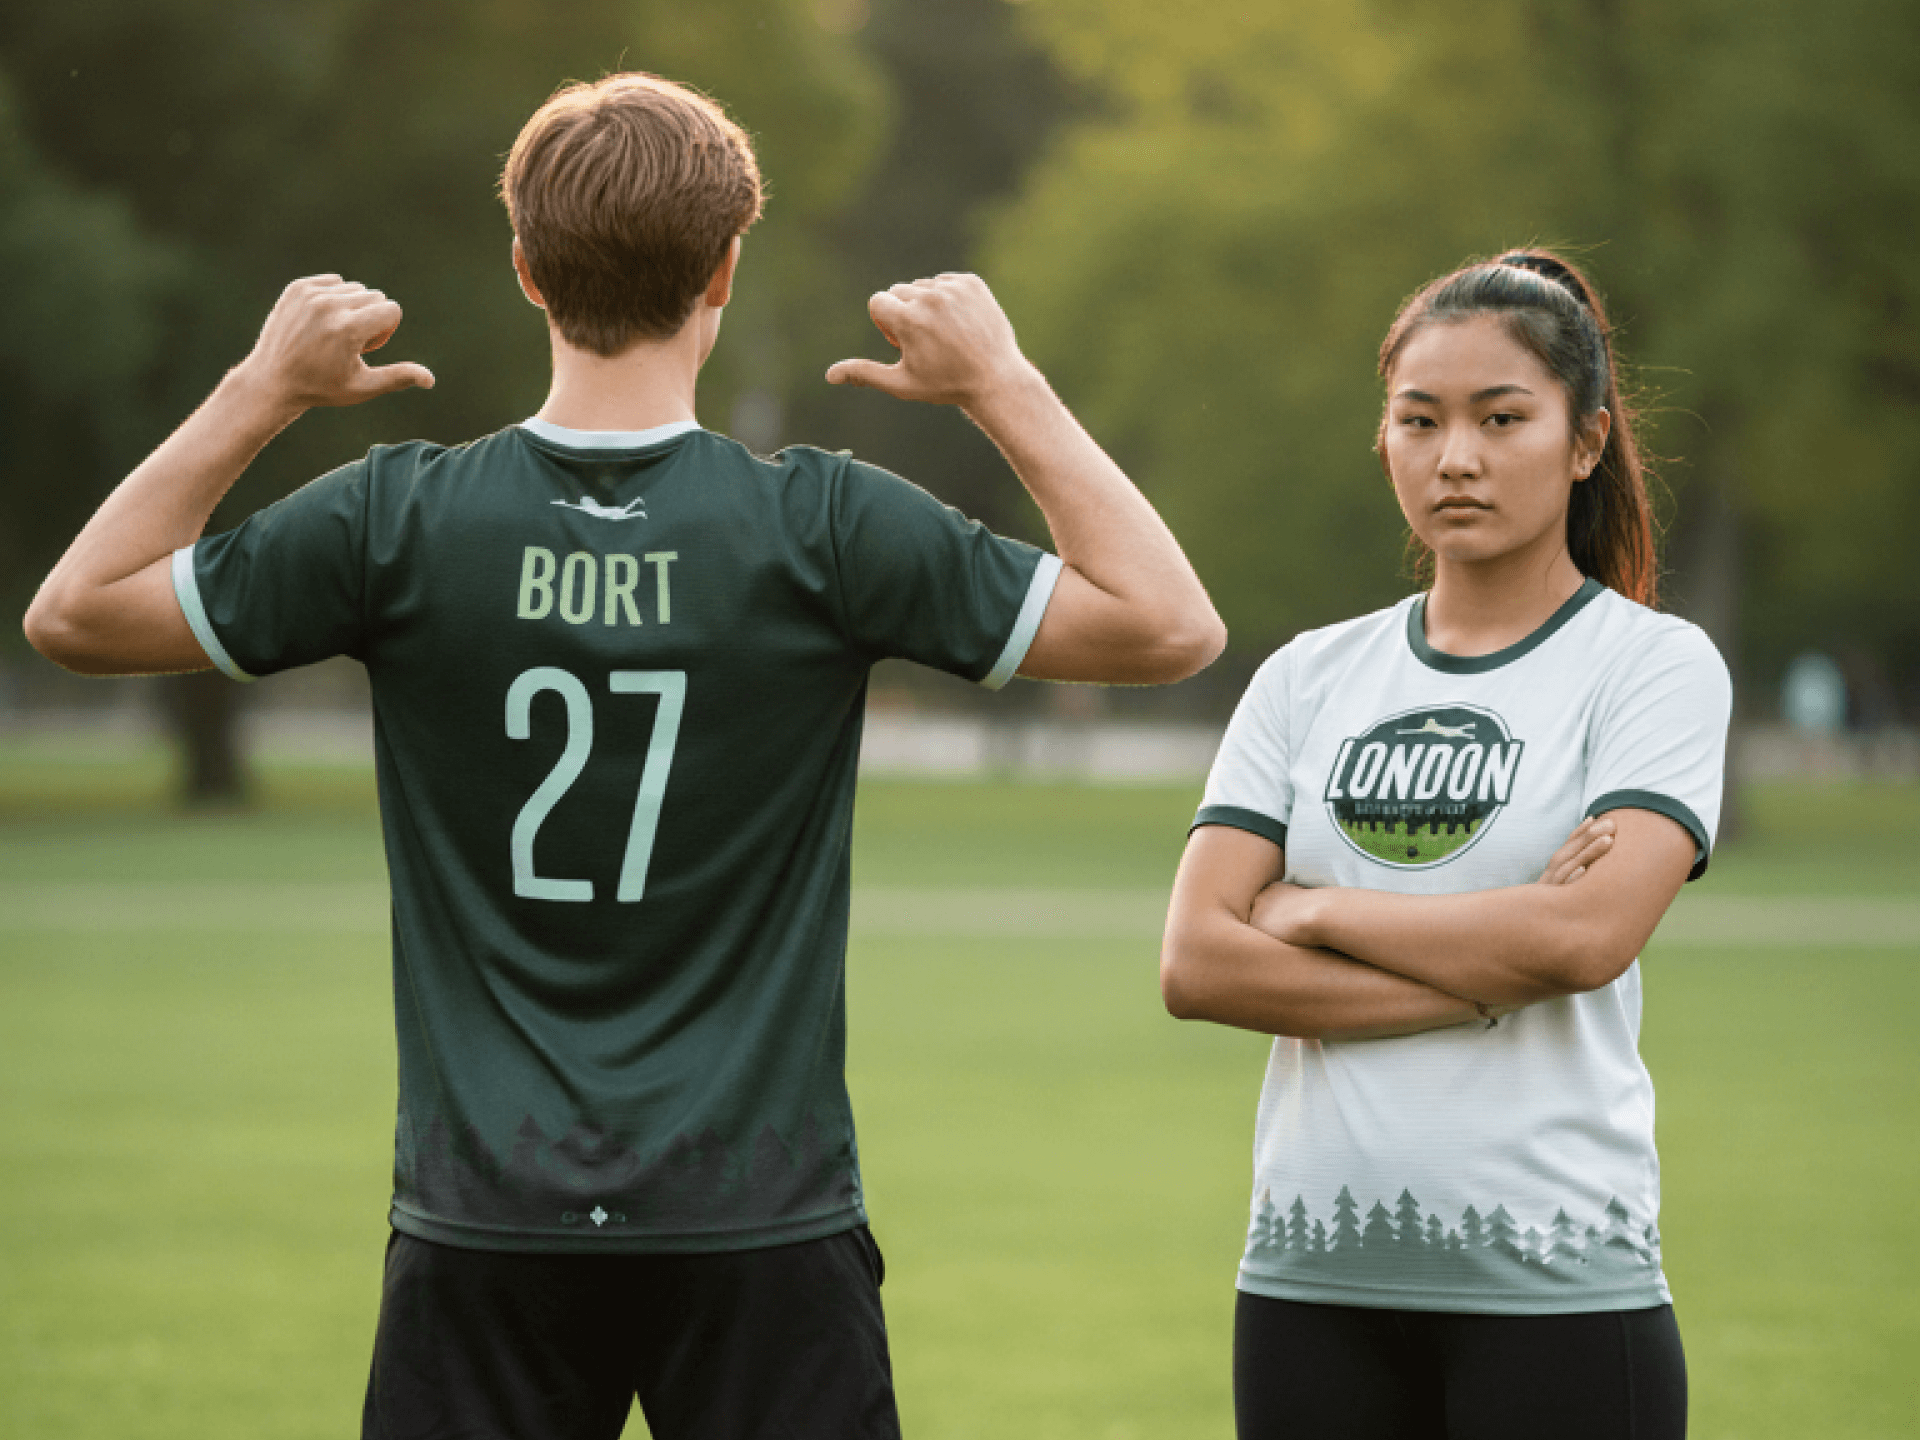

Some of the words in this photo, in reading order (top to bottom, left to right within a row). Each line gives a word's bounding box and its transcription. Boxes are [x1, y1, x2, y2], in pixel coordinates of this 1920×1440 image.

[517, 546, 678, 626] BORT
[505, 666, 687, 902] 27
[1326, 738, 1521, 802] LONDON
